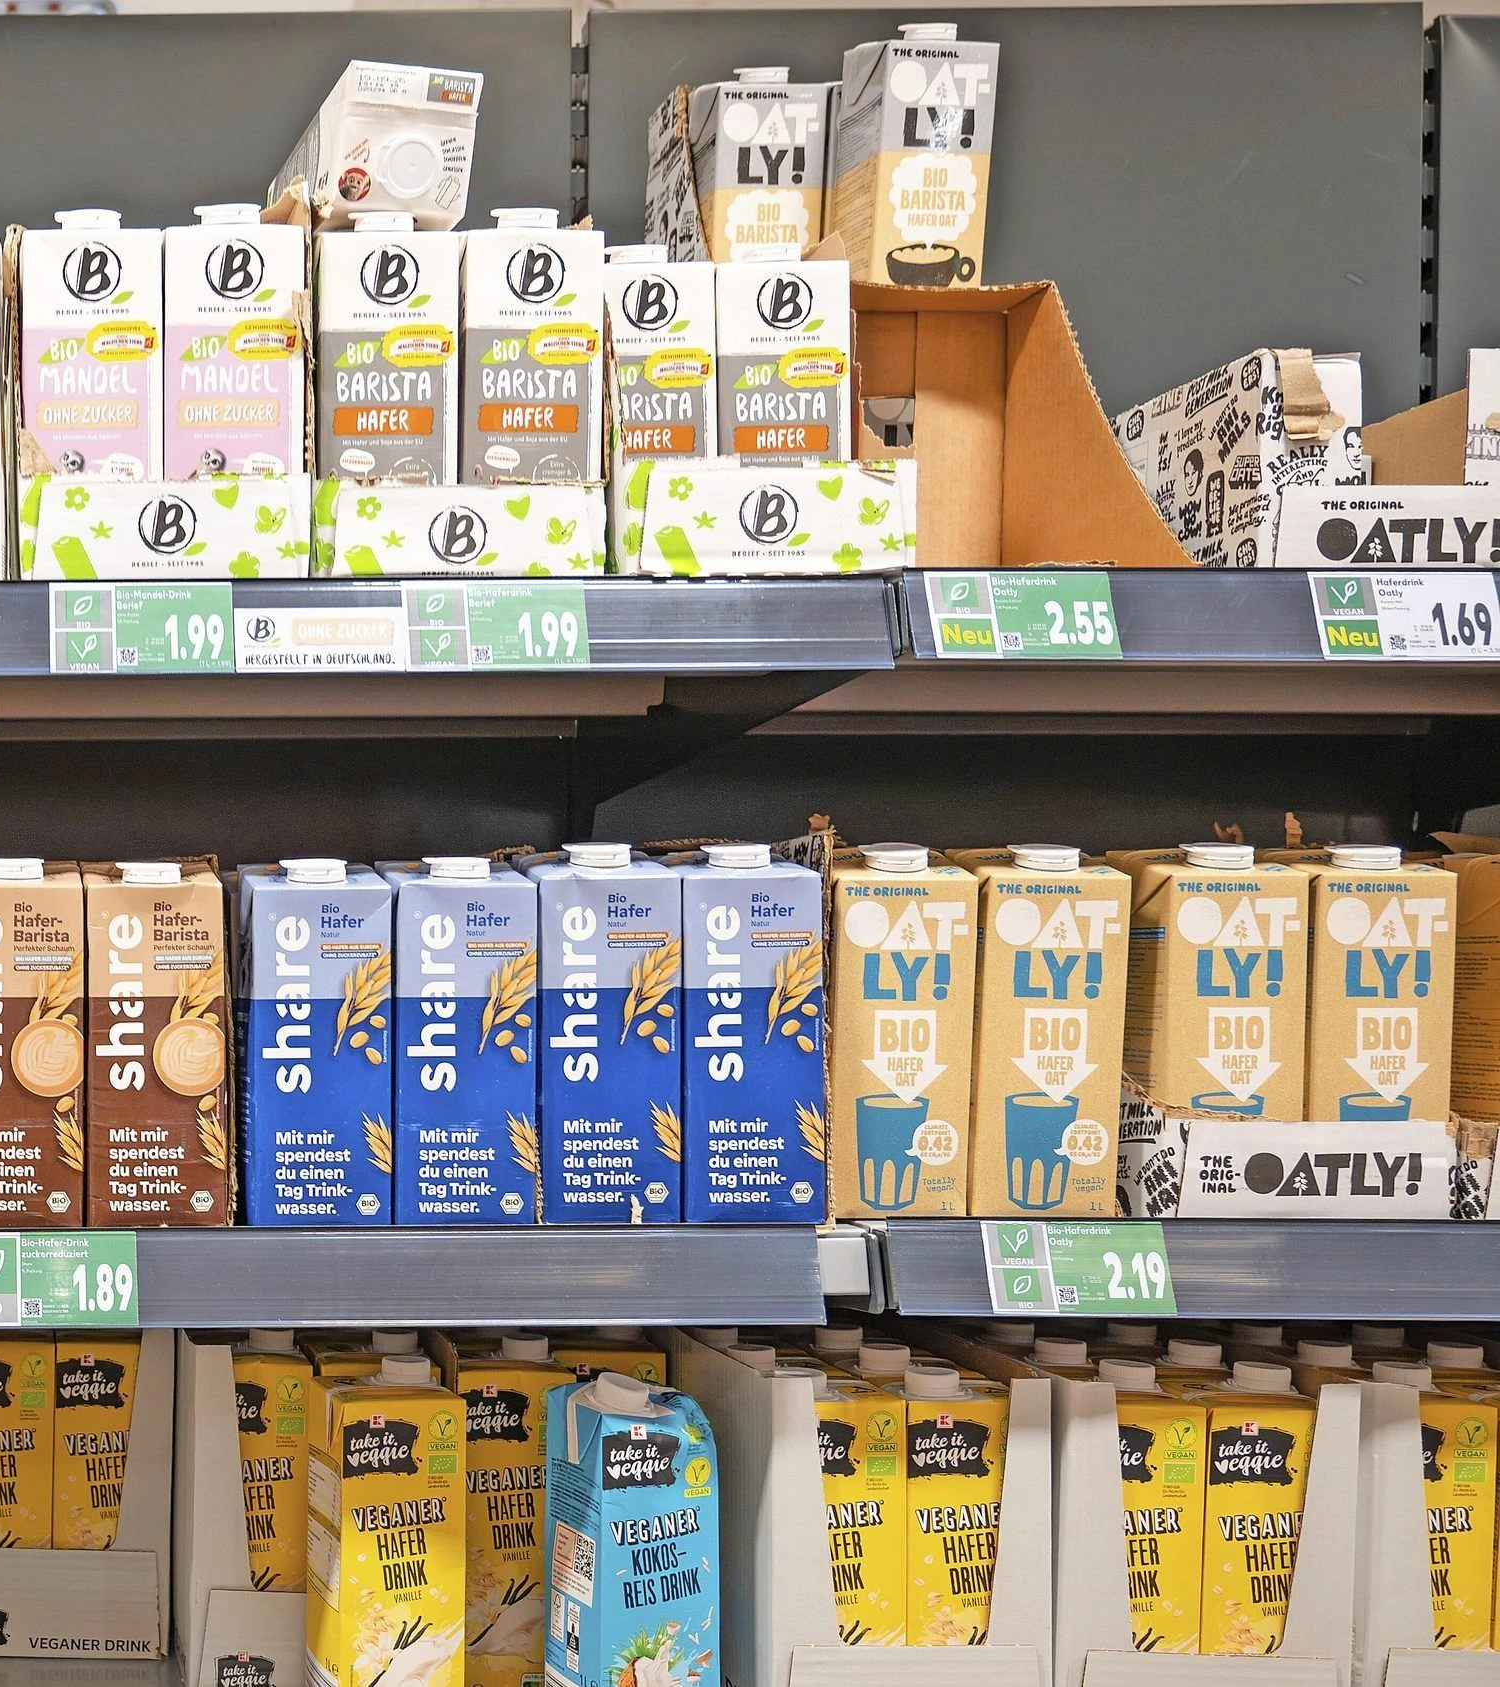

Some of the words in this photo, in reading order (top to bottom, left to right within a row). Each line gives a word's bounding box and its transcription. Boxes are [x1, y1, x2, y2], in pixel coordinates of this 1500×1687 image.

[893, 48, 913, 58] THE
[916, 49, 959, 59] ORIGINAL
[923, 167, 948, 188] BIO
[900, 189, 966, 212] BARISTA
[908, 214, 937, 227] HAFER
[939, 215, 958, 228] OAT
[39, 364, 138, 395] MANDEL
[43, 406, 78, 425] OHNE
[82, 403, 133, 424] ZUCKER
[357, 411, 409, 432] HAFER
[757, 429, 807, 450] HAFER
[1234, 455, 1260, 467] SUPER
[1267, 445, 1329, 475] REALLY
[1230, 468, 1261, 482] OATS
[1271, 458, 1328, 486] INTERESTING
[1322, 500, 1346, 510] THE
[1350, 500, 1404, 510] ORIGINAL
[992, 577, 1057, 586] Bio-Haferdrink
[1376, 579, 1424, 587] Haferdrink
[994, 587, 1018, 598] Oatly
[1378, 589, 1403, 598] Oatly
[1044, 600, 1113, 645] 2.55
[1431, 603, 1492, 646] 1.69
[164, 614, 224, 661] 1.99
[518, 611, 579, 658] 1.99
[942, 624, 992, 645] Neu
[1327, 626, 1379, 647] Neu
[845, 887, 870, 897] THE
[873, 887, 929, 897] ORIGINAL
[751, 904, 795, 918] Hafer
[321, 916, 364, 928] Hafer
[14, 945, 46, 955] Perfekter
[47, 944, 75, 953] Schaum
[864, 952, 951, 1001] LY!
[262, 916, 311, 1094] share
[880, 1018, 930, 1052] BIO
[887, 1057, 923, 1073] HAFER
[895, 1072, 917, 1087] OAT
[708, 1137, 784, 1153] spendest
[1067, 1136, 1102, 1151] 0.42
[1072, 1177, 1106, 1185] Totally
[1244, 1152, 1422, 1197] OATLY!
[276, 1184, 302, 1199] Tag
[306, 1184, 352, 1197] Trink-
[1075, 1185, 1104, 1193] vegan.
[276, 1202, 337, 1215] wasser.
[1047, 1226, 1111, 1235] Bio-Haferdrink
[21, 1250, 89, 1259] zuckerreduziert
[1102, 1251, 1166, 1300] 2.19
[72, 1263, 133, 1312] 1.89
[1456, 1450, 1486, 1458] VEGAN
[1215, 1451, 1284, 1476] veggie
[376, 1530, 427, 1561] HAFER
[631, 1543, 687, 1577] KOKOS-
[383, 1561, 428, 1592] DRINK
[623, 1578, 657, 1610] REIS
[661, 1567, 701, 1602] DRINK
[394, 1591, 422, 1603] VANILLE
[29, 1637, 100, 1651] VEGANER
[105, 1639, 151, 1652] DRINK
